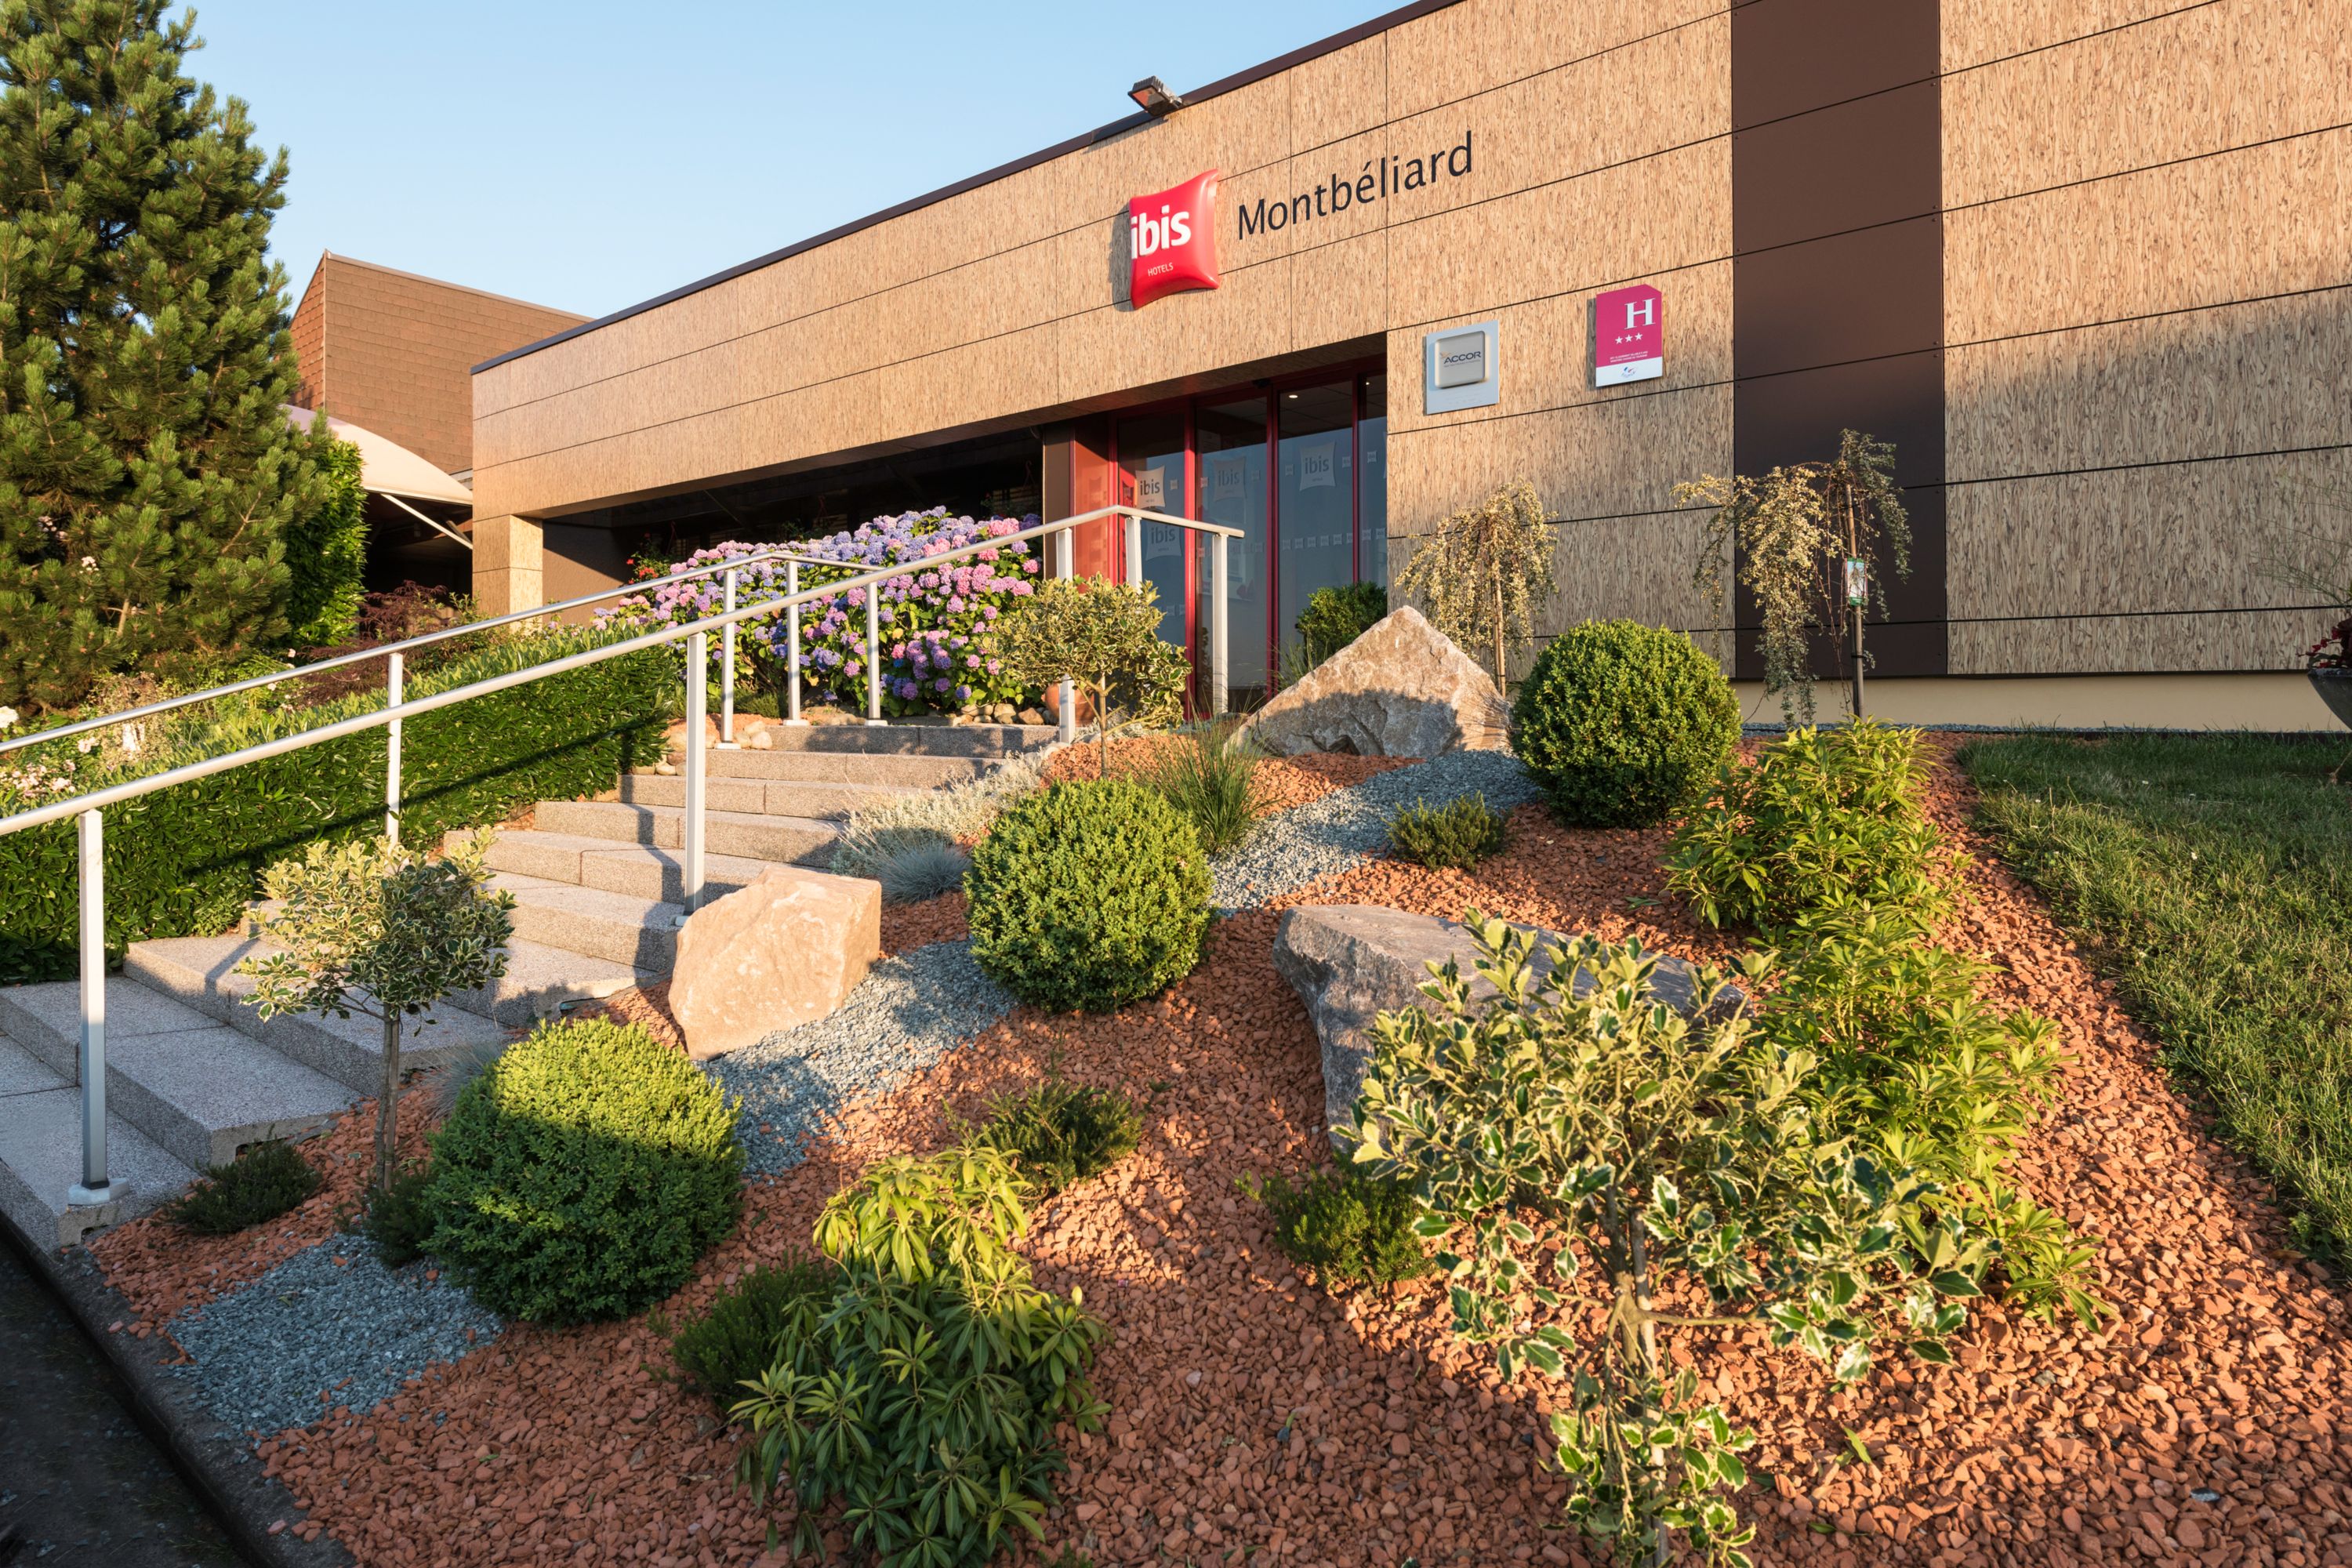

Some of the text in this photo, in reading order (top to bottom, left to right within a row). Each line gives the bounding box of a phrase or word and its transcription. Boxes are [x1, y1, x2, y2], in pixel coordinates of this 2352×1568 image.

[1238, 130, 1472, 240] Montbéliard
[1131, 204, 1192, 260] ibis
[1147, 262, 1174, 277] HOTELS
[1624, 297, 1656, 330] H
[1443, 350, 1482, 365] ACCOR
[1305, 455, 1330, 474] ibis
[1218, 467, 1240, 487] ibis
[1140, 478, 1160, 496] ibis
[1151, 525, 1176, 544] ibis
